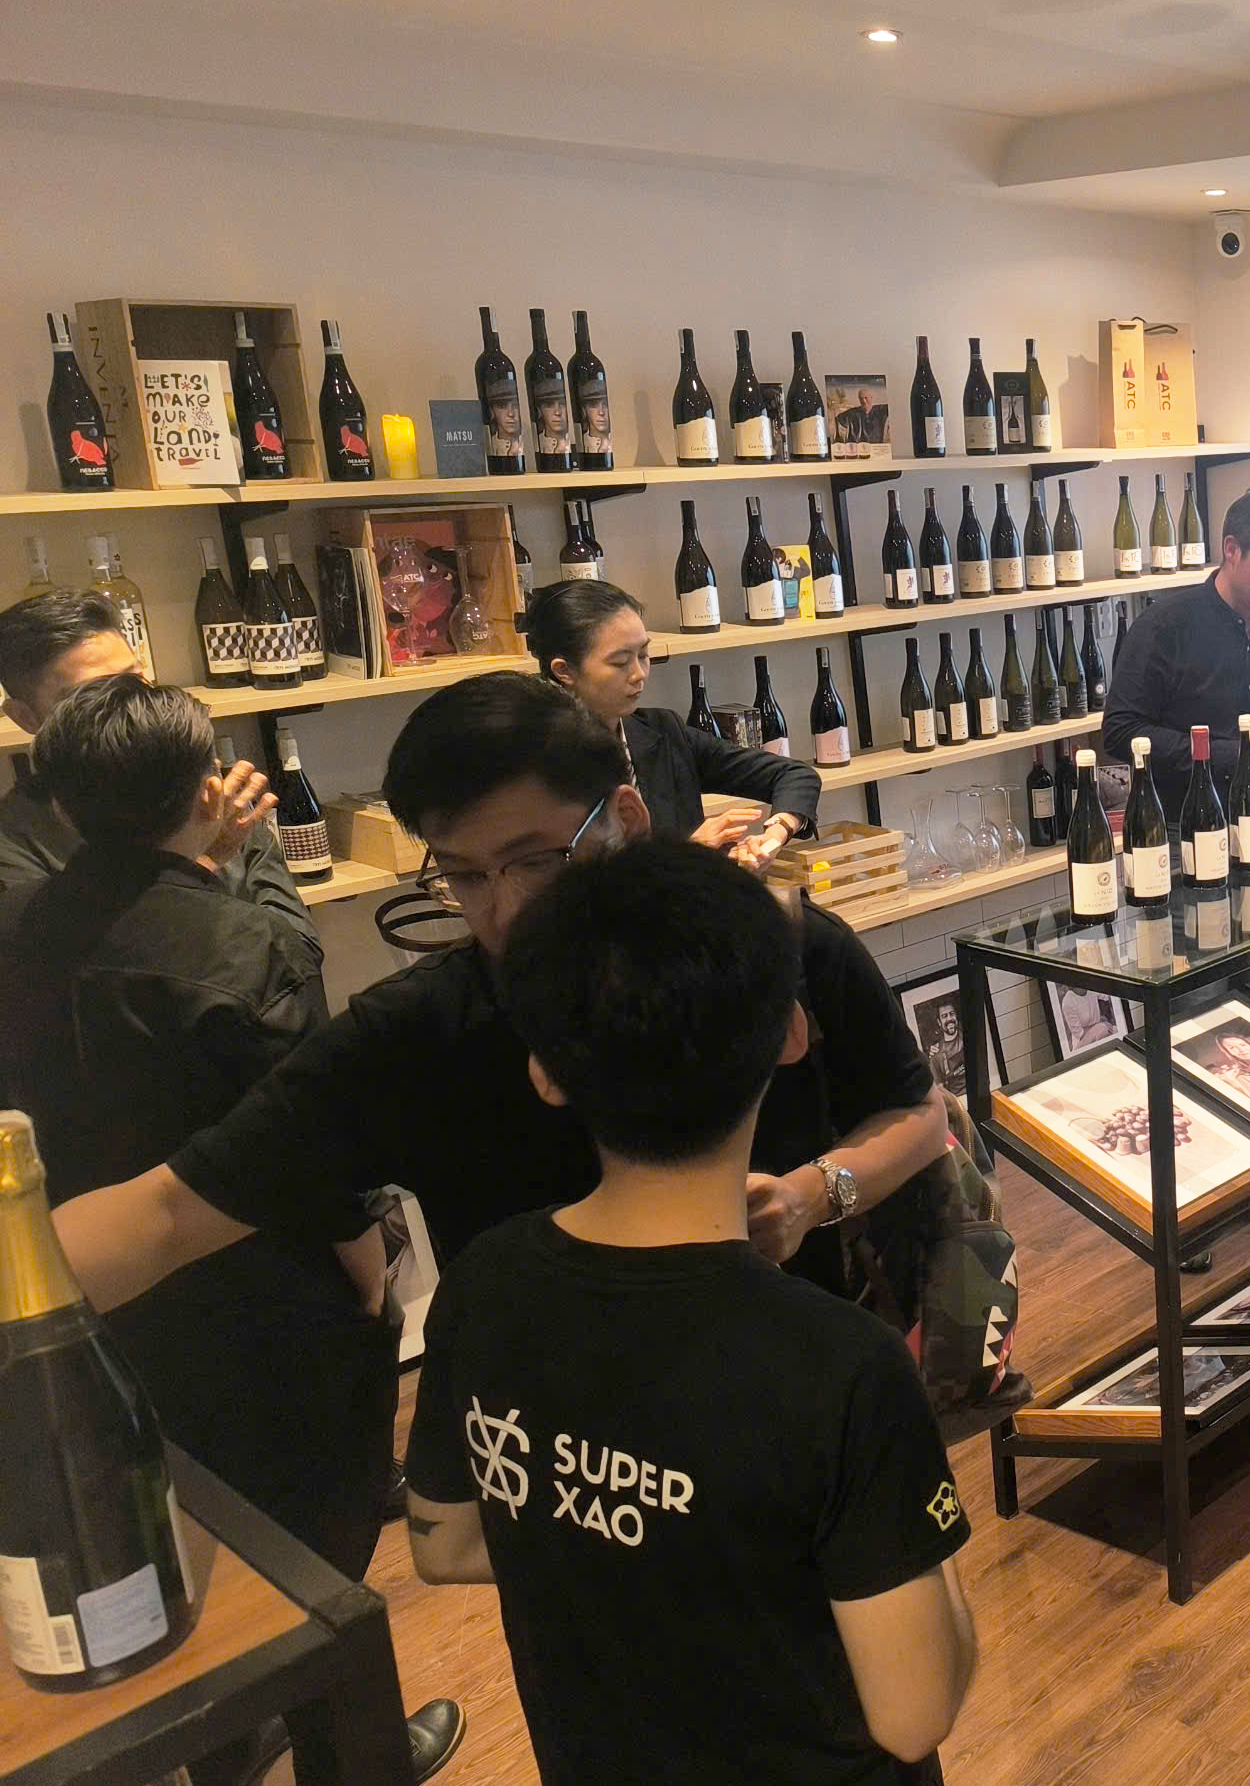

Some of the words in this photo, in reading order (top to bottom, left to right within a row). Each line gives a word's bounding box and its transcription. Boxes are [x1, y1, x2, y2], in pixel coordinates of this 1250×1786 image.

[144, 373, 203, 390] LET'S
[1126, 381, 1136, 410] ATC
[1161, 383, 1171, 411] ATC
[152, 410, 187, 424] OUR
[446, 430, 473, 441] MATSU
[554, 1433, 694, 1514] SUPER
[553, 1481, 644, 1547] XAO
